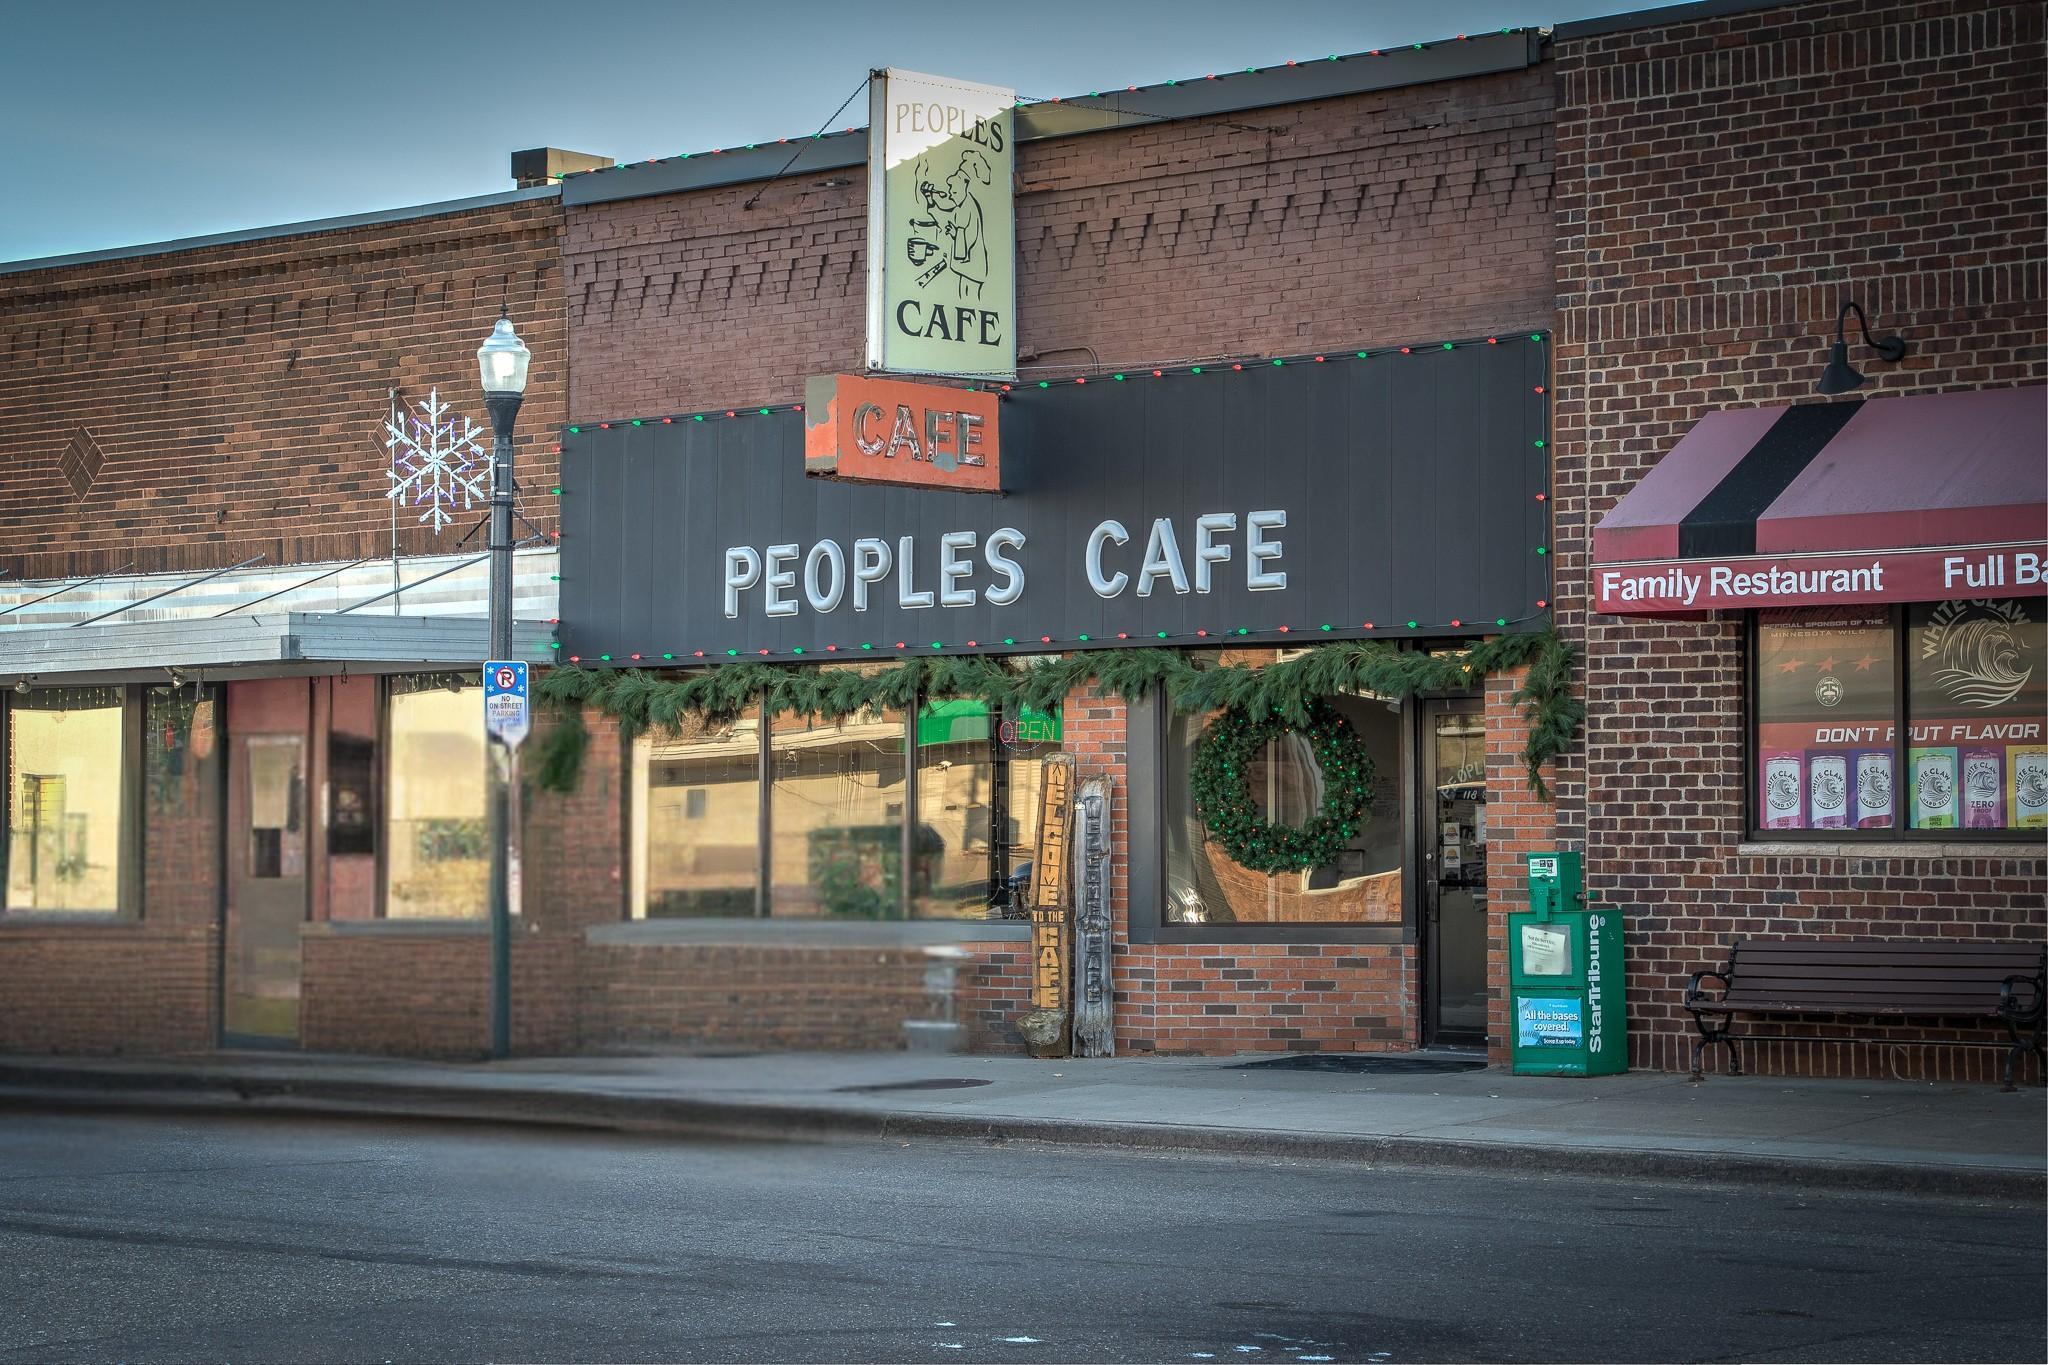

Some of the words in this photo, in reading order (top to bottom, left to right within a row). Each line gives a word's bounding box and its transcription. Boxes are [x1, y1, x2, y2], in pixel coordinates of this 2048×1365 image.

[896, 103, 1004, 153] PEOPLES
[896, 300, 1002, 347] CAFE
[852, 401, 986, 467] CAFE
[724, 527, 1028, 619] PEOPLES
[1085, 509, 1287, 599] CAFE
[1602, 568, 1702, 605] Family
[1709, 560, 1884, 597] Restaurant
[1944, 553, 2005, 589] Full
[1763, 621, 1803, 630] OFFICIAL
[1805, 620, 1848, 628] SPONSOR
[1770, 630, 1832, 638] MINNESOTA
[1922, 600, 1967, 660] WHITE
[489, 702, 499, 710] ON
[500, 702, 523, 710] STREET
[1000, 720, 1054, 743] OPEN
[1815, 727, 1879, 743] DON'T
[1950, 723, 2041, 741] FLAVOR
[1441, 761, 1486, 800] PEOPL
[1767, 772, 1778, 797] WHITE
[1778, 770, 1797, 783] CLAW
[1812, 771, 1823, 796] WHITE
[1823, 769, 1844, 783] CLAW
[1858, 768, 1869, 794] WHITE
[1869, 766, 1890, 780] CLAW
[1918, 770, 1929, 795] WHITE
[1929, 767, 1951, 781] CLAW
[1966, 764, 1978, 784] WHITE
[1979, 761, 1997, 774] CLAW
[2016, 768, 2027, 793] WHITE
[1463, 790, 1478, 800] 118
[1970, 800, 1995, 809] ZERO
[1031, 910, 1044, 922] TO
[1048, 910, 1065, 922] THE
[1588, 914, 1602, 1053] StarTribune
[1524, 1009, 1537, 1021] All
[1537, 1011, 1552, 1021] the
[1552, 1011, 1579, 1021] bases
[1533, 1021, 1570, 1033] covered.
